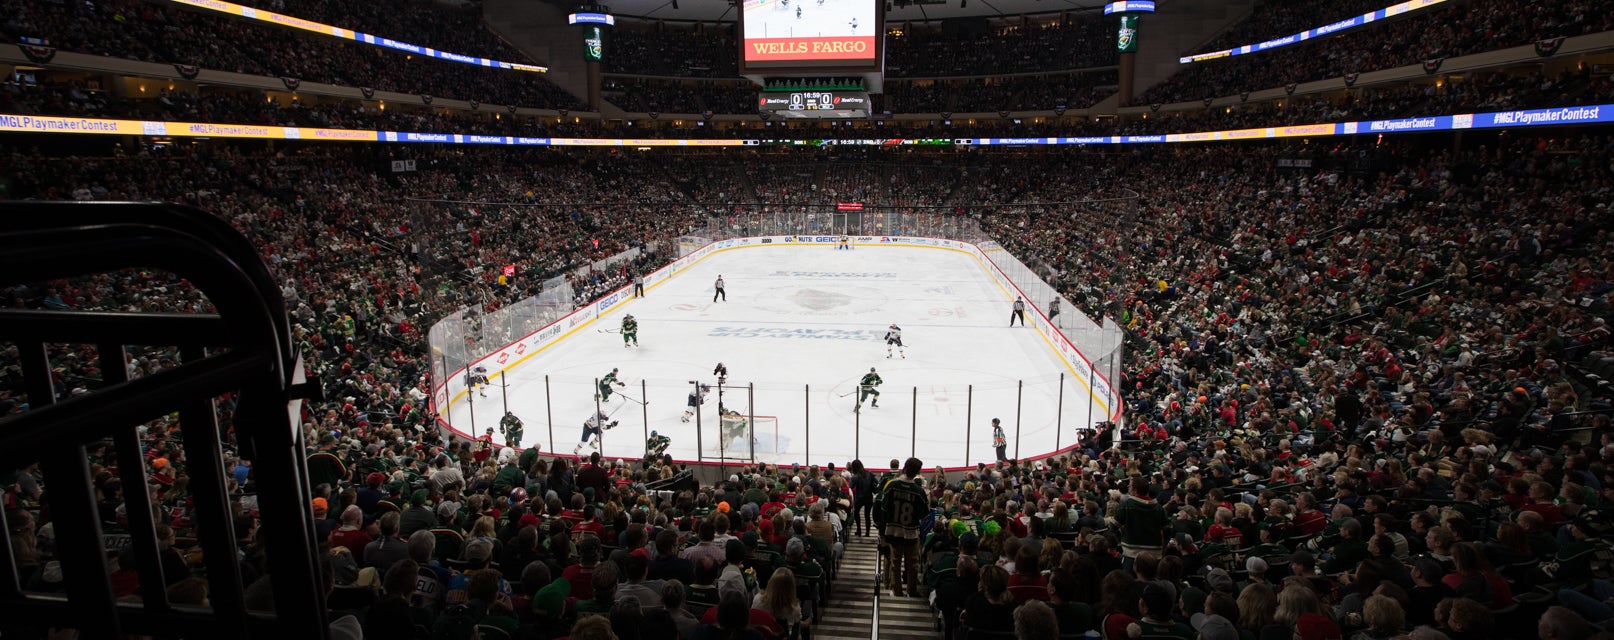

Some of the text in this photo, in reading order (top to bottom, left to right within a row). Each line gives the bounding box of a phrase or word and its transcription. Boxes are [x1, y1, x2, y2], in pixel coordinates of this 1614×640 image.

[753, 41, 866, 54] WELLS FARGO
[793, 94, 801, 105] 0
[822, 94, 831, 104] 0
[1494, 106, 1600, 125] #MGLPlaymakerContest
[189, 124, 269, 136] #MGLPlaymakerContest
[1370, 117, 1435, 131] #MGLPlaymakerContest
[600, 294, 619, 311] GEICO
[894, 500, 914, 525] 18
